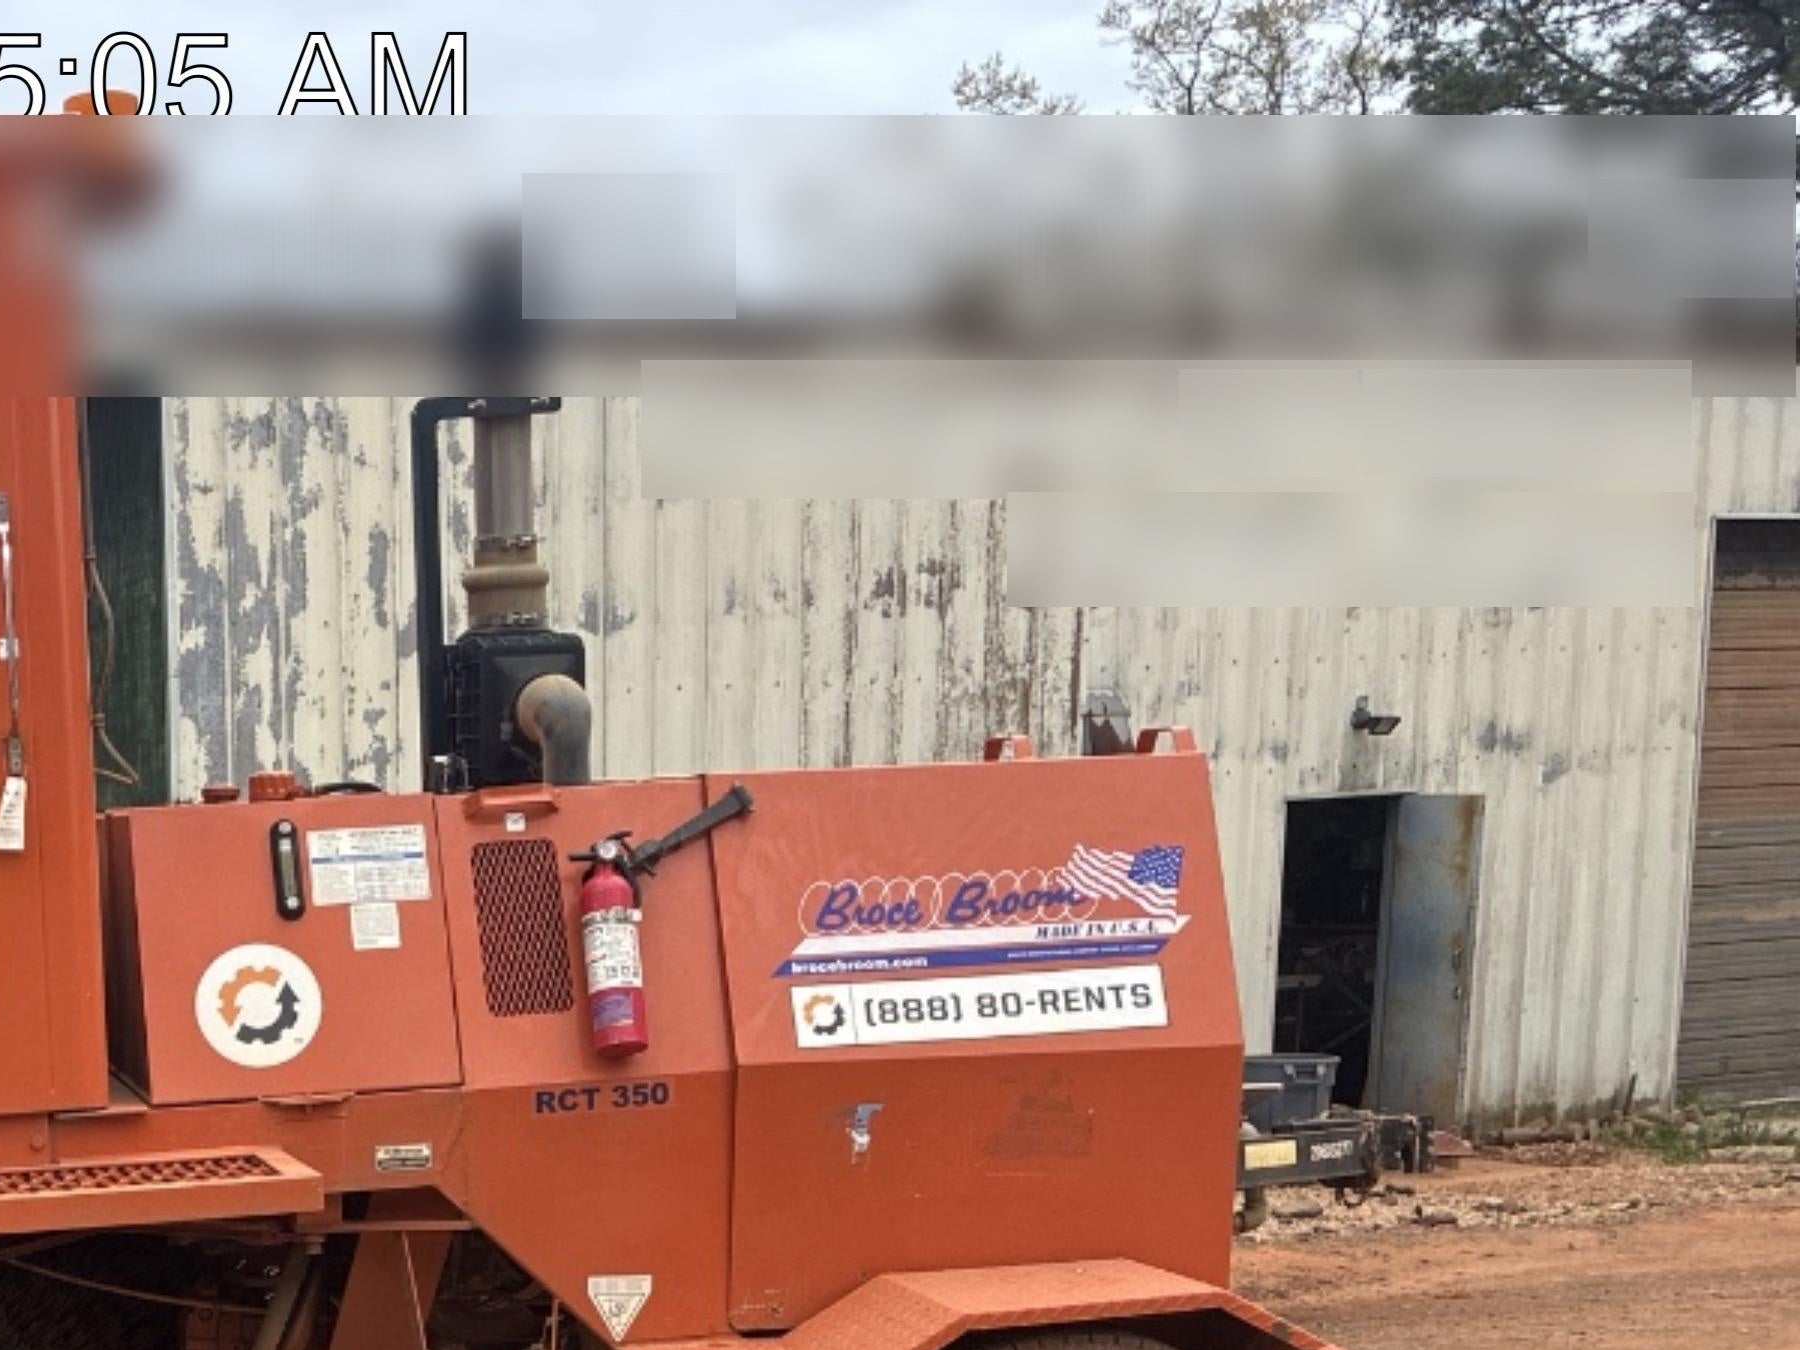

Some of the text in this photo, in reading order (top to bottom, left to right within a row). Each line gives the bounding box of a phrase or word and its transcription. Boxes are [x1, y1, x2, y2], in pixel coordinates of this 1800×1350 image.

[815, 880, 1096, 931] Broce Broom
[864, 983, 1152, 1025] (888) 80-RENTS
[536, 1082, 670, 1113] RCT 350
